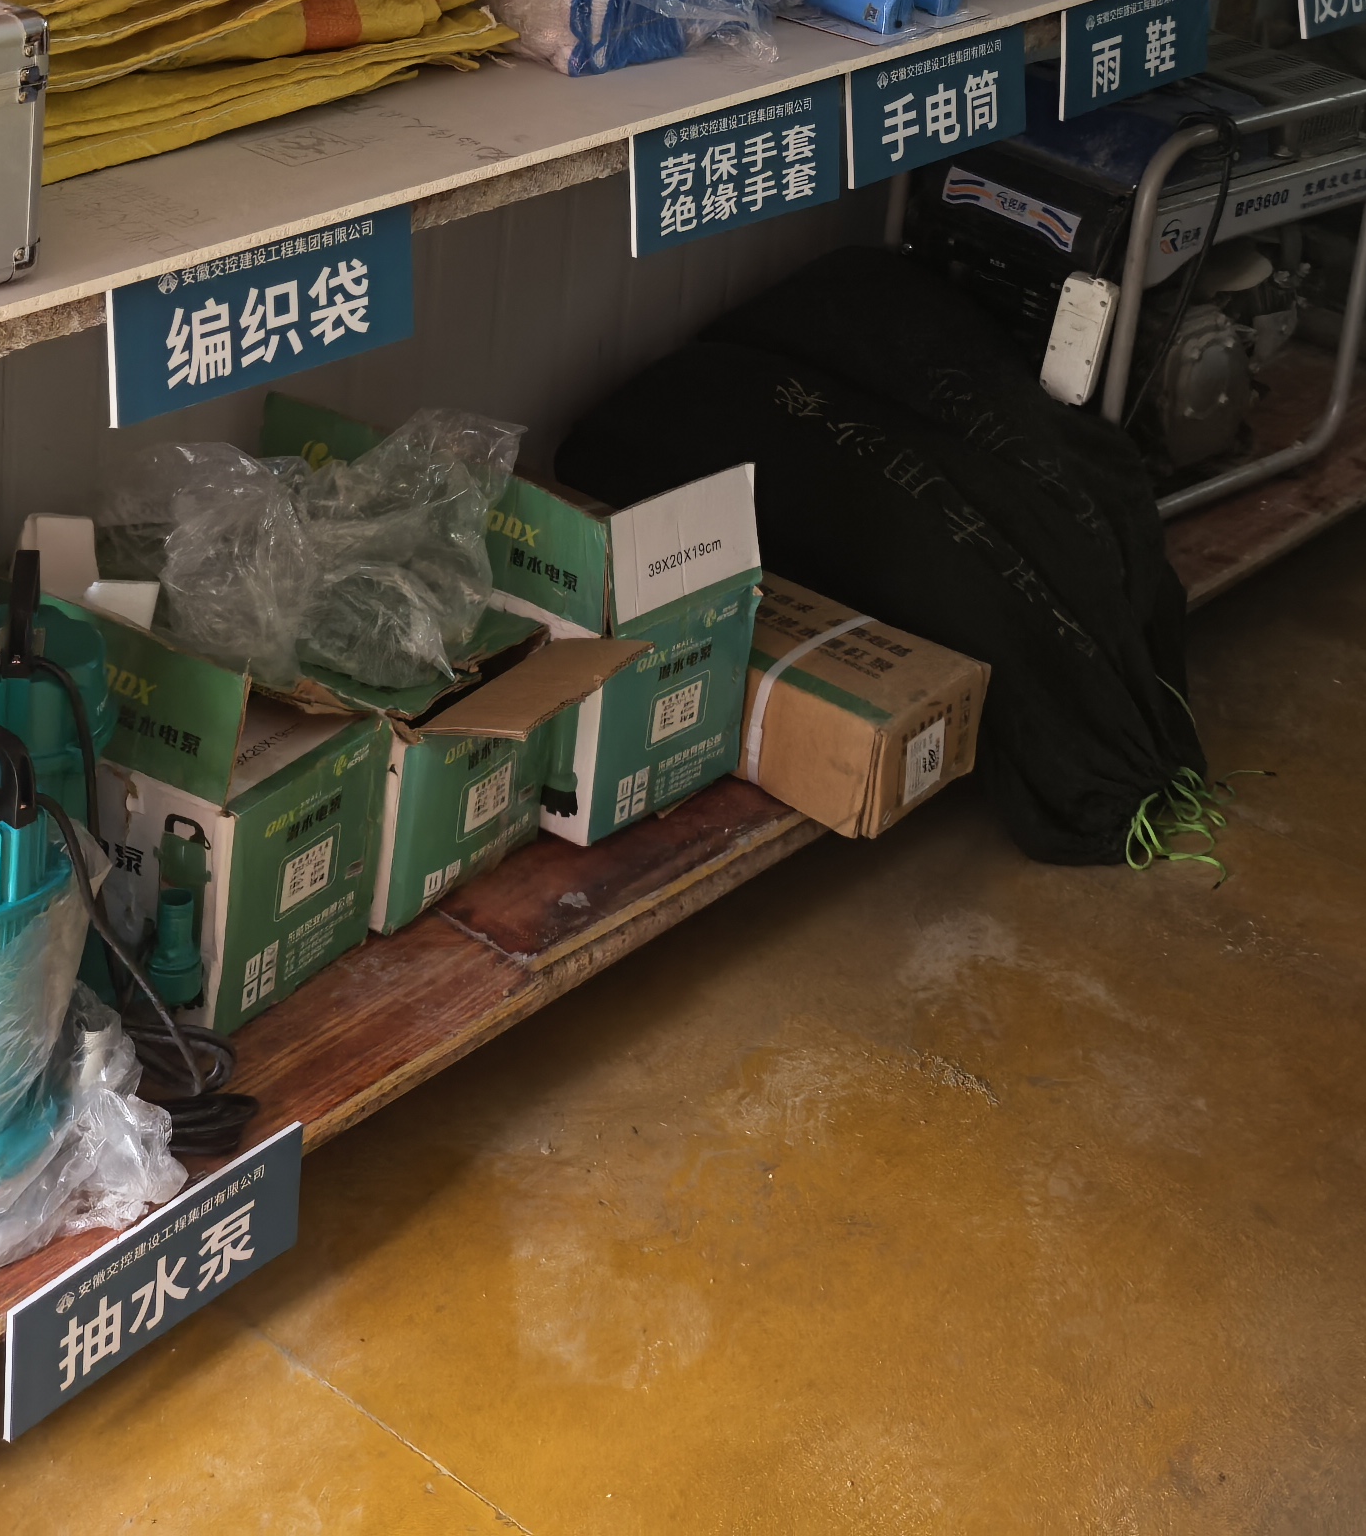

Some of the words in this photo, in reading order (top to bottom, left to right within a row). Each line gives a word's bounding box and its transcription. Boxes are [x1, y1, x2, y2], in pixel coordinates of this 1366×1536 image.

[890, 40, 1002, 83] 安徽交控建设工程集团有限公司
[1091, 16, 1177, 99] 雨鞋
[679, 97, 813, 142] 安徽交控建设工程集团有限公司
[881, 69, 999, 162] 手电筒
[660, 123, 816, 197] 劳保手套
[660, 161, 816, 237] 绝缘手套
[182, 220, 374, 286] 安徽交控建设工程集团有限公司
[166, 258, 371, 390] 编织袋
[648, 538, 722, 579] 39X20X19cm
[78, 1164, 266, 1299] 安徽交控建设工程集团有限公司
[59, 1199, 256, 1392] 抽水泵
